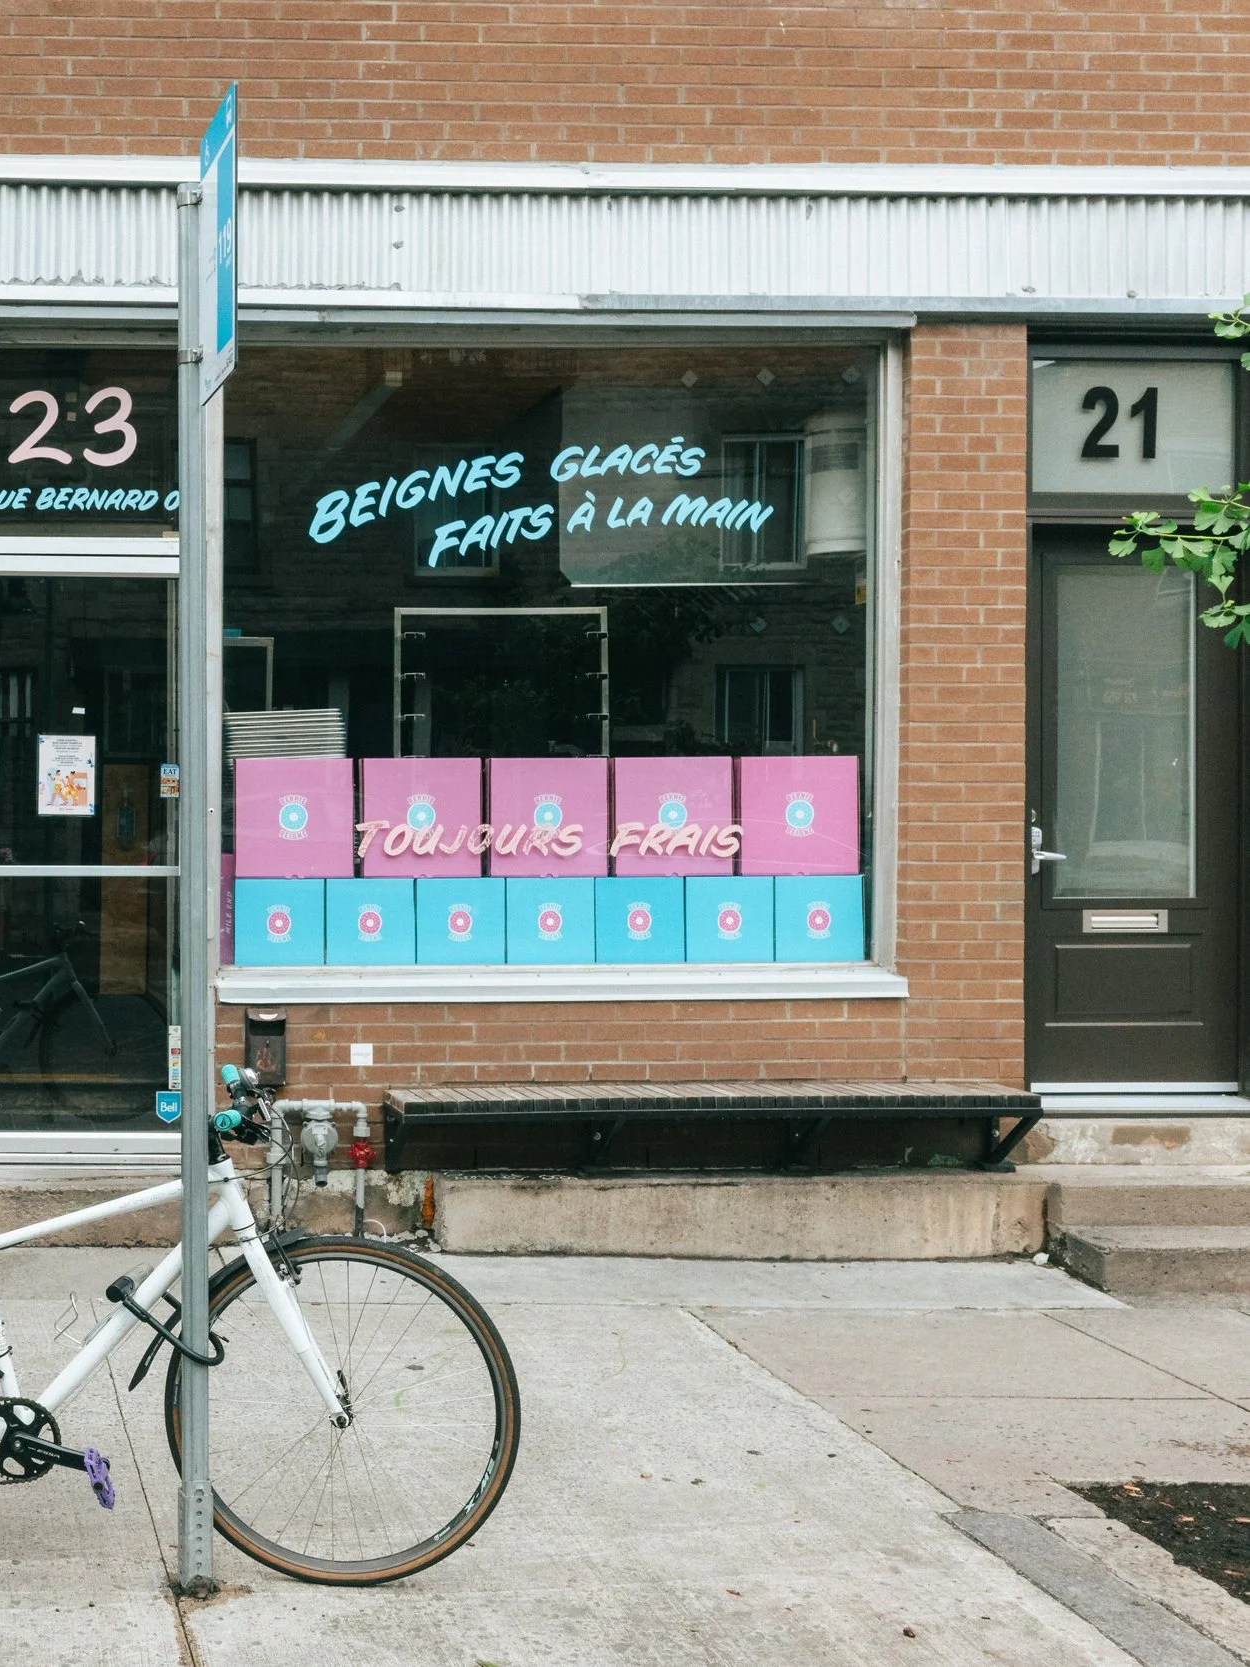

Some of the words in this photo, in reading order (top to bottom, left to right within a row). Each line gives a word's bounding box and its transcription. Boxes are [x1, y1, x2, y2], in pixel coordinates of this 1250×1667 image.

[218, 217, 232, 264] 119
[7, 386, 138, 467] 23
[1081, 386, 1158, 459] 21
[35, 487, 160, 511] BERNARD
[308, 452, 524, 544] BEIGNES
[550, 436, 706, 483] GLACÉS
[428, 503, 555, 567] FAITS
[566, 490, 596, 534] À
[606, 496, 654, 529] LA
[661, 493, 774, 534] MAIN
[356, 820, 584, 858] TOUJOURS
[609, 822, 744, 858] FRAIS
[160, 1102, 178, 1112] Bell
